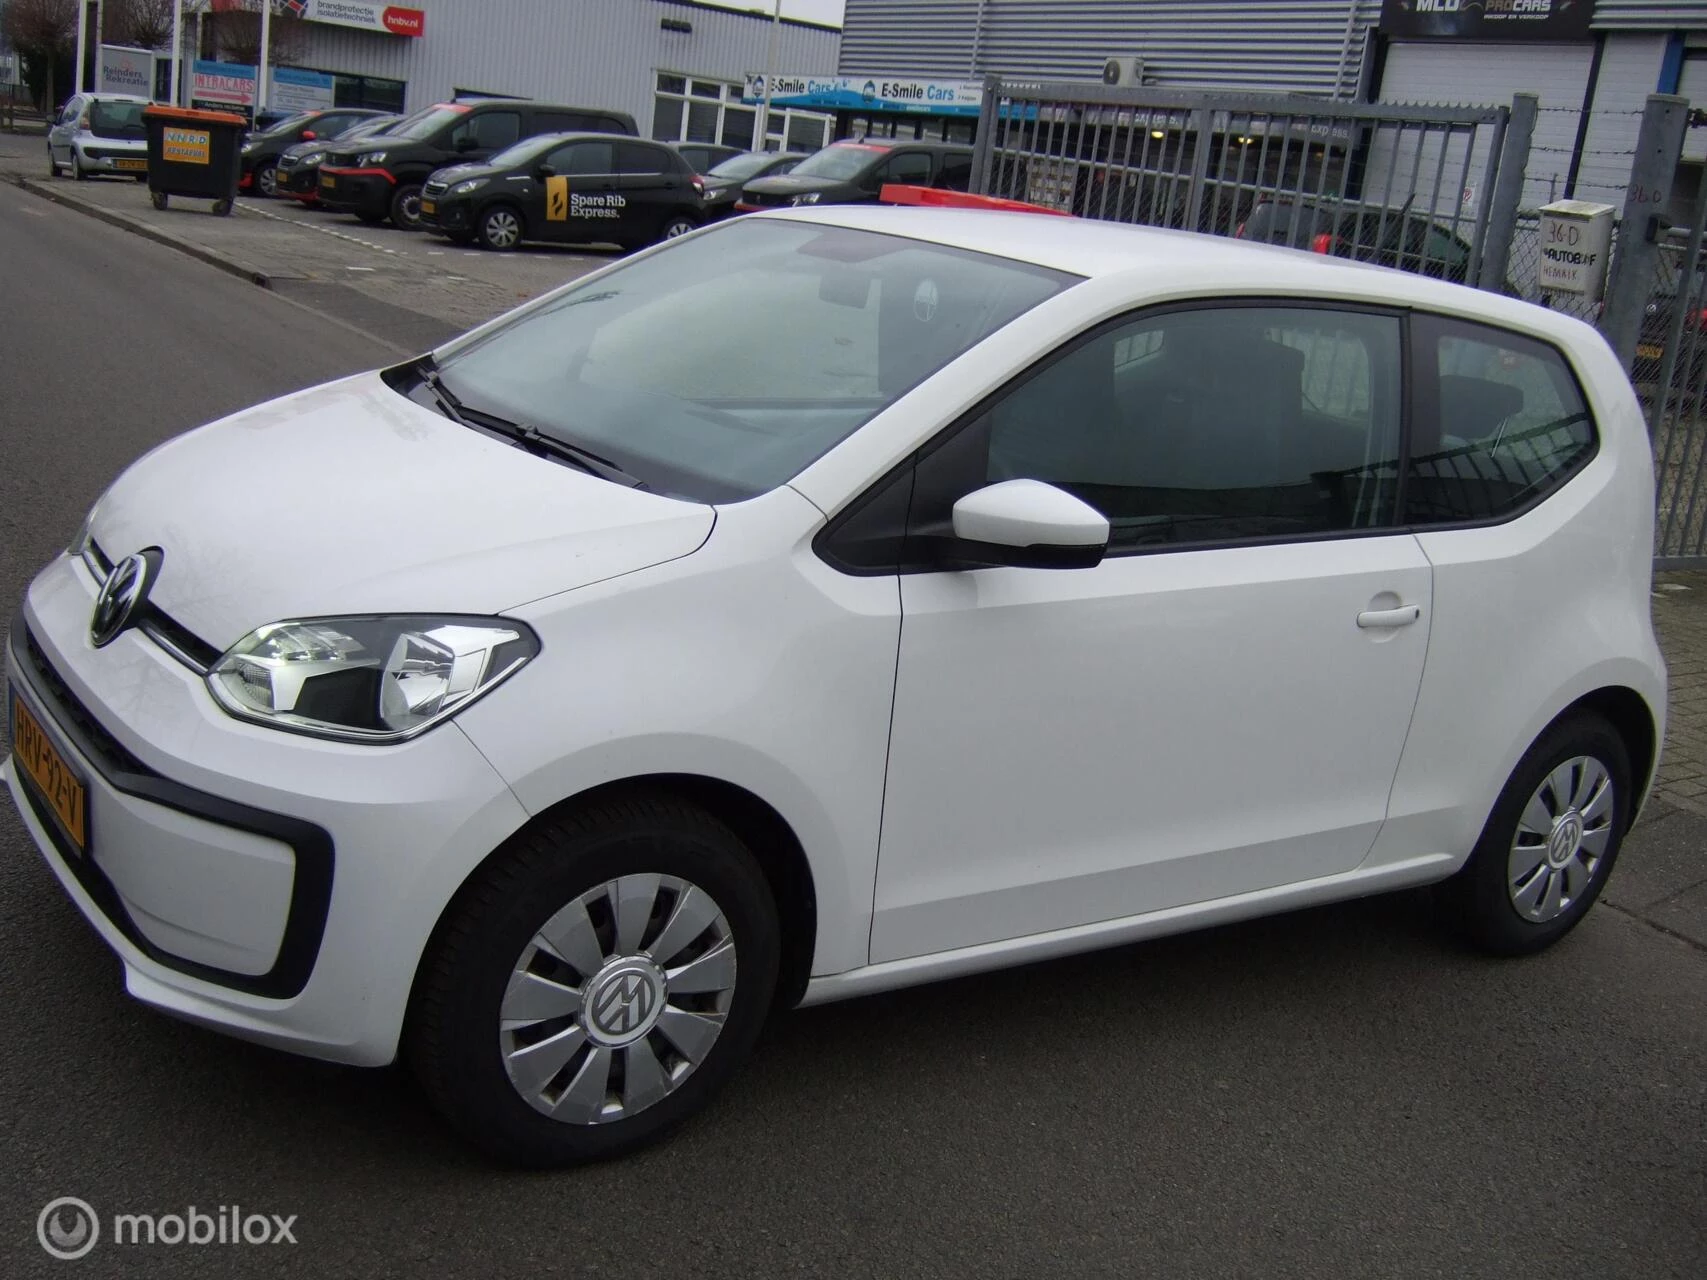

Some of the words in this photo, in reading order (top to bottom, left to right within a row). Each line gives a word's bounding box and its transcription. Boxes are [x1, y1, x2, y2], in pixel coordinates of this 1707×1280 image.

[317, 0, 374, 15] brandprotectie
[317, 9, 376, 24] isolatietechniek
[388, 16, 418, 28] hnbv.nl
[194, 74, 254, 92] INTRACARS
[770, 78, 805, 94] E-Smile
[808, 80, 831, 95] Cars
[881, 83, 924, 100] E-Smile
[927, 85, 955, 101] Cars
[570, 193, 605, 207] Spare
[606, 195, 626, 207] Rib
[570, 206, 620, 219] Express.
